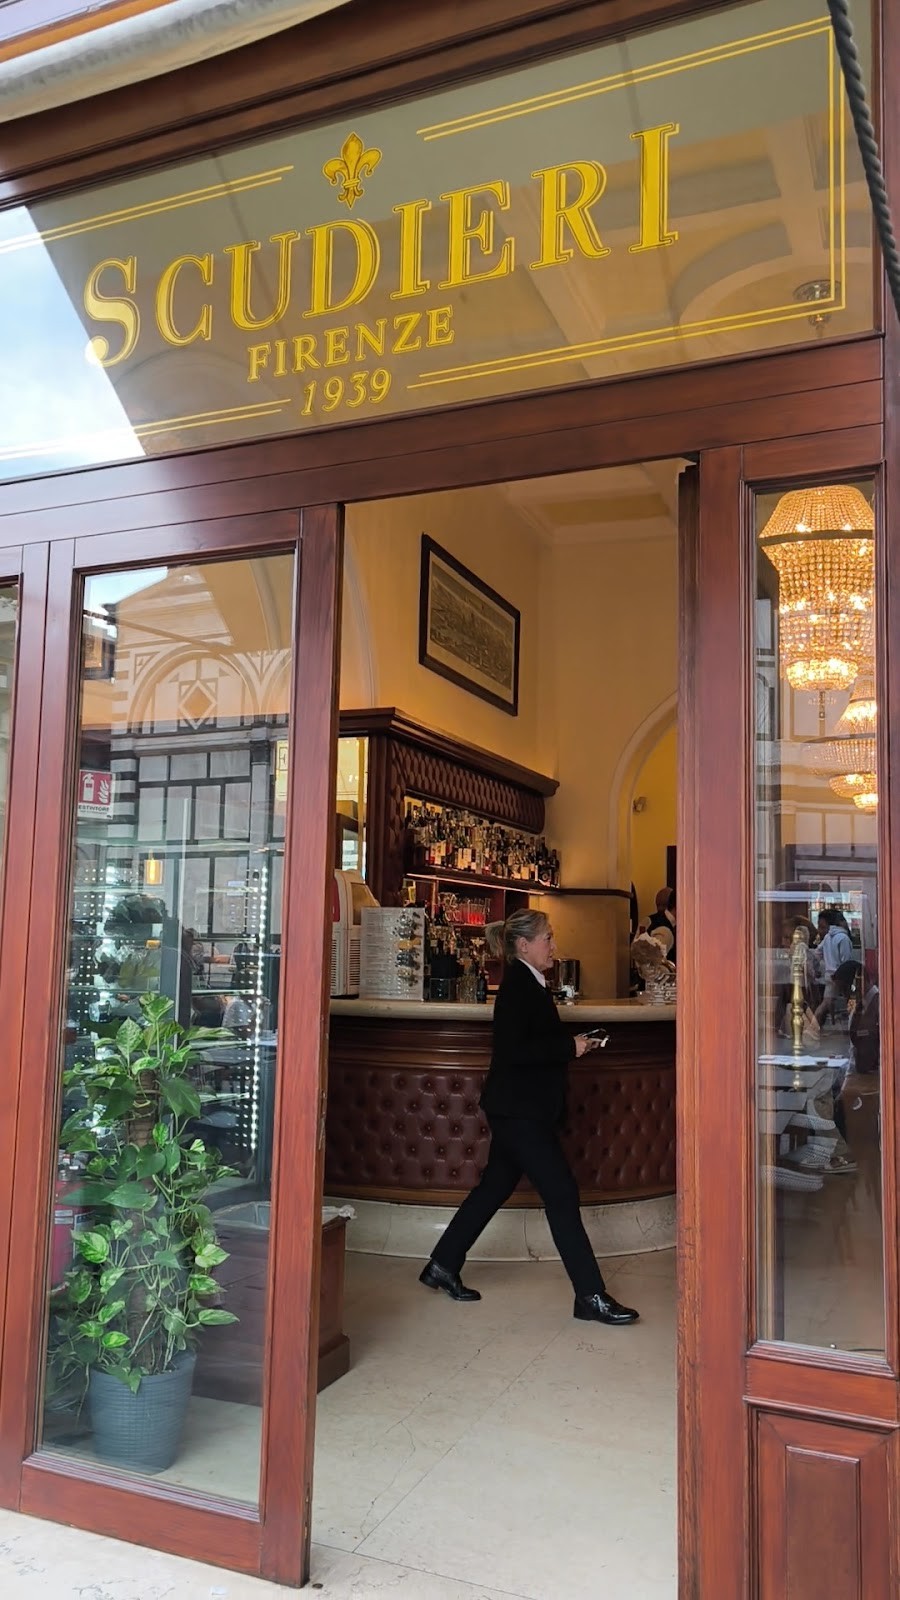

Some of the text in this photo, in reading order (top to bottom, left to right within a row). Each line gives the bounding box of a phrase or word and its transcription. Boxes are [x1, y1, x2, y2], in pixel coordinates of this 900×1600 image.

[84, 123, 680, 367] SCUDIERI
[247, 304, 455, 382] FIRENZE
[301, 367, 391, 415] 1939
